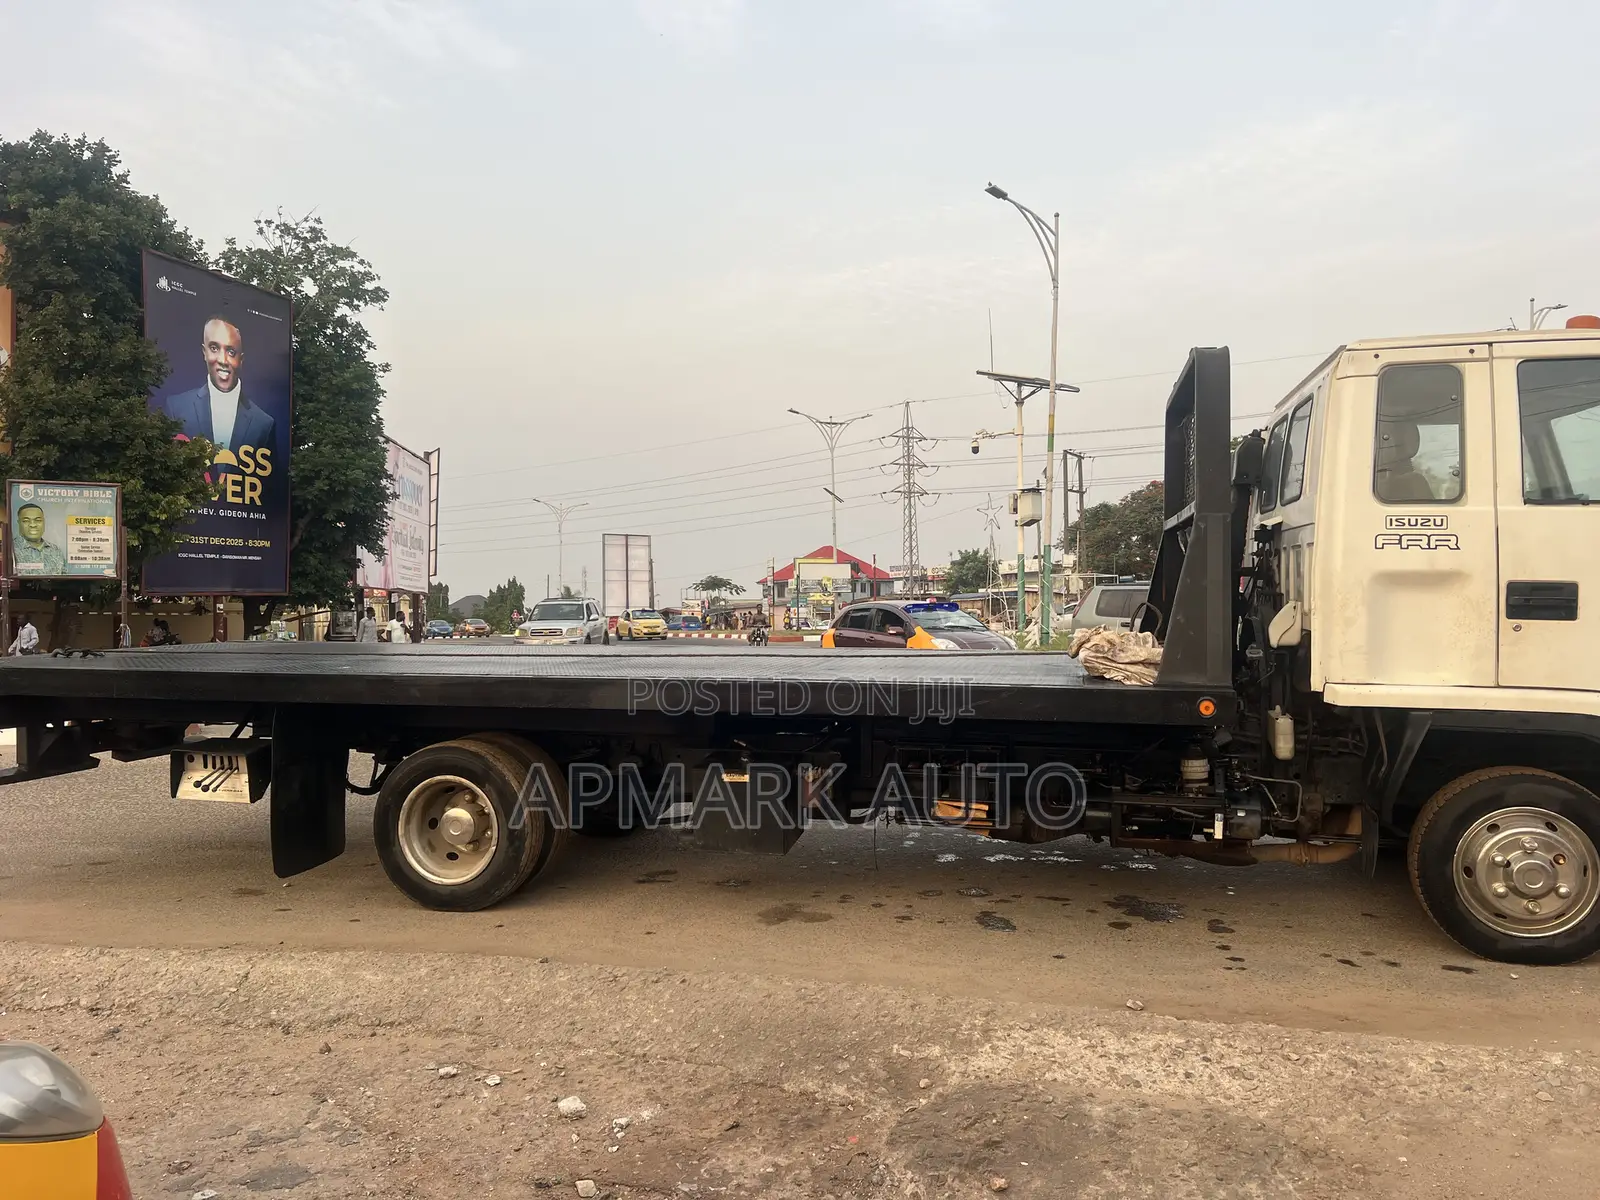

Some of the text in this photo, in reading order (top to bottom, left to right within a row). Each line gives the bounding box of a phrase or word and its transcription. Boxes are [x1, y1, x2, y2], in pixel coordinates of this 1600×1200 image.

[37, 488, 112, 499] VICTORY BIBLE
[218, 509, 248, 519] GIDEON
[249, 512, 267, 520] AHIA
[75, 517, 106, 525] SERVICES
[1389, 517, 1444, 527] ISUZU
[190, 536, 209, 544] 31ST
[209, 537, 226, 545] DEC
[226, 538, 244, 546] 2025
[1374, 533, 1461, 550] FRR
